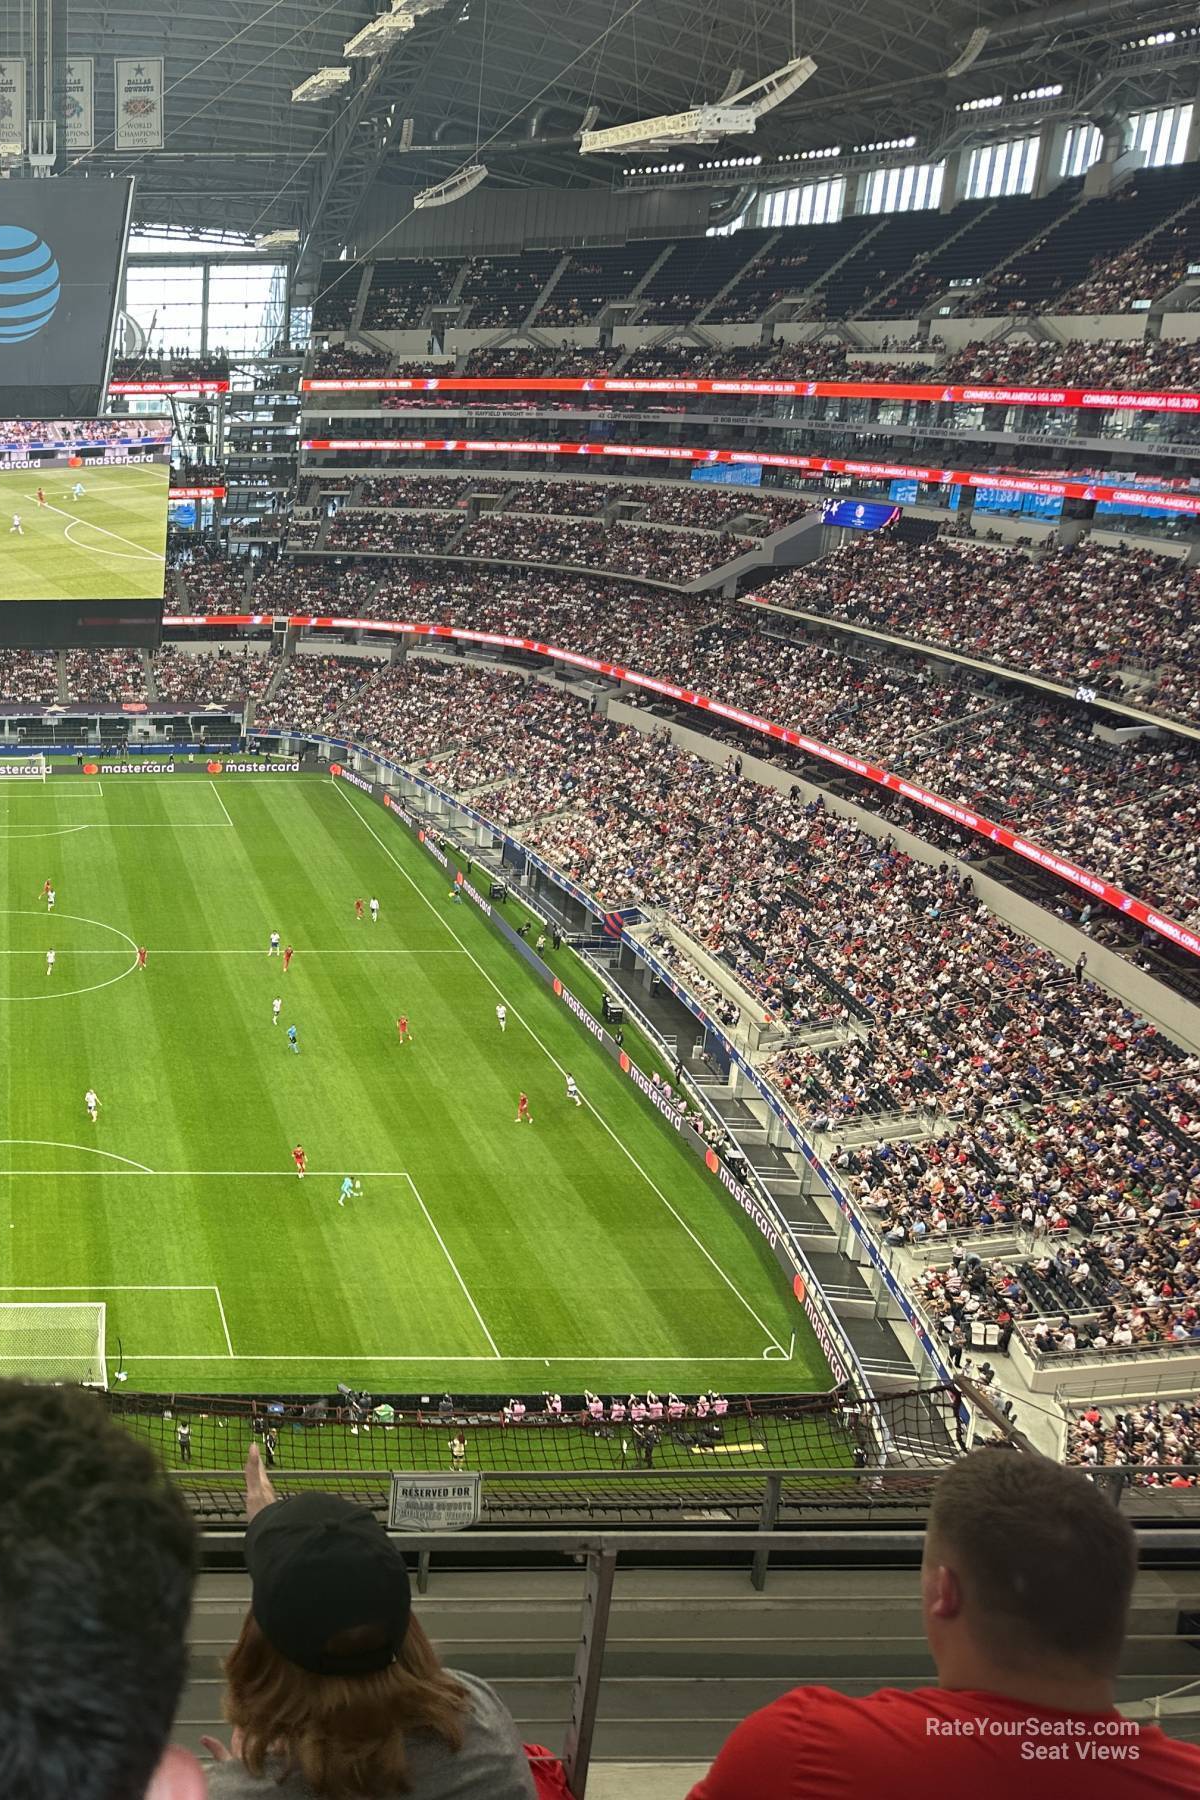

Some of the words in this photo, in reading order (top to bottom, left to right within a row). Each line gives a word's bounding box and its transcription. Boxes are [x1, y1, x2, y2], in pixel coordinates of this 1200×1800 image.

[85, 454, 154, 465] mastercard
[102, 763, 174, 774] mastercard
[226, 762, 300, 772] mastercard
[342, 769, 372, 793] mastercard
[463, 879, 491, 916] mastercard
[562, 990, 603, 1041] mastercard
[631, 1066, 682, 1132] mastercard
[720, 1167, 778, 1250] mastercard
[402, 1488, 448, 1497] RESERVED
[452, 1487, 470, 1496] FOR
